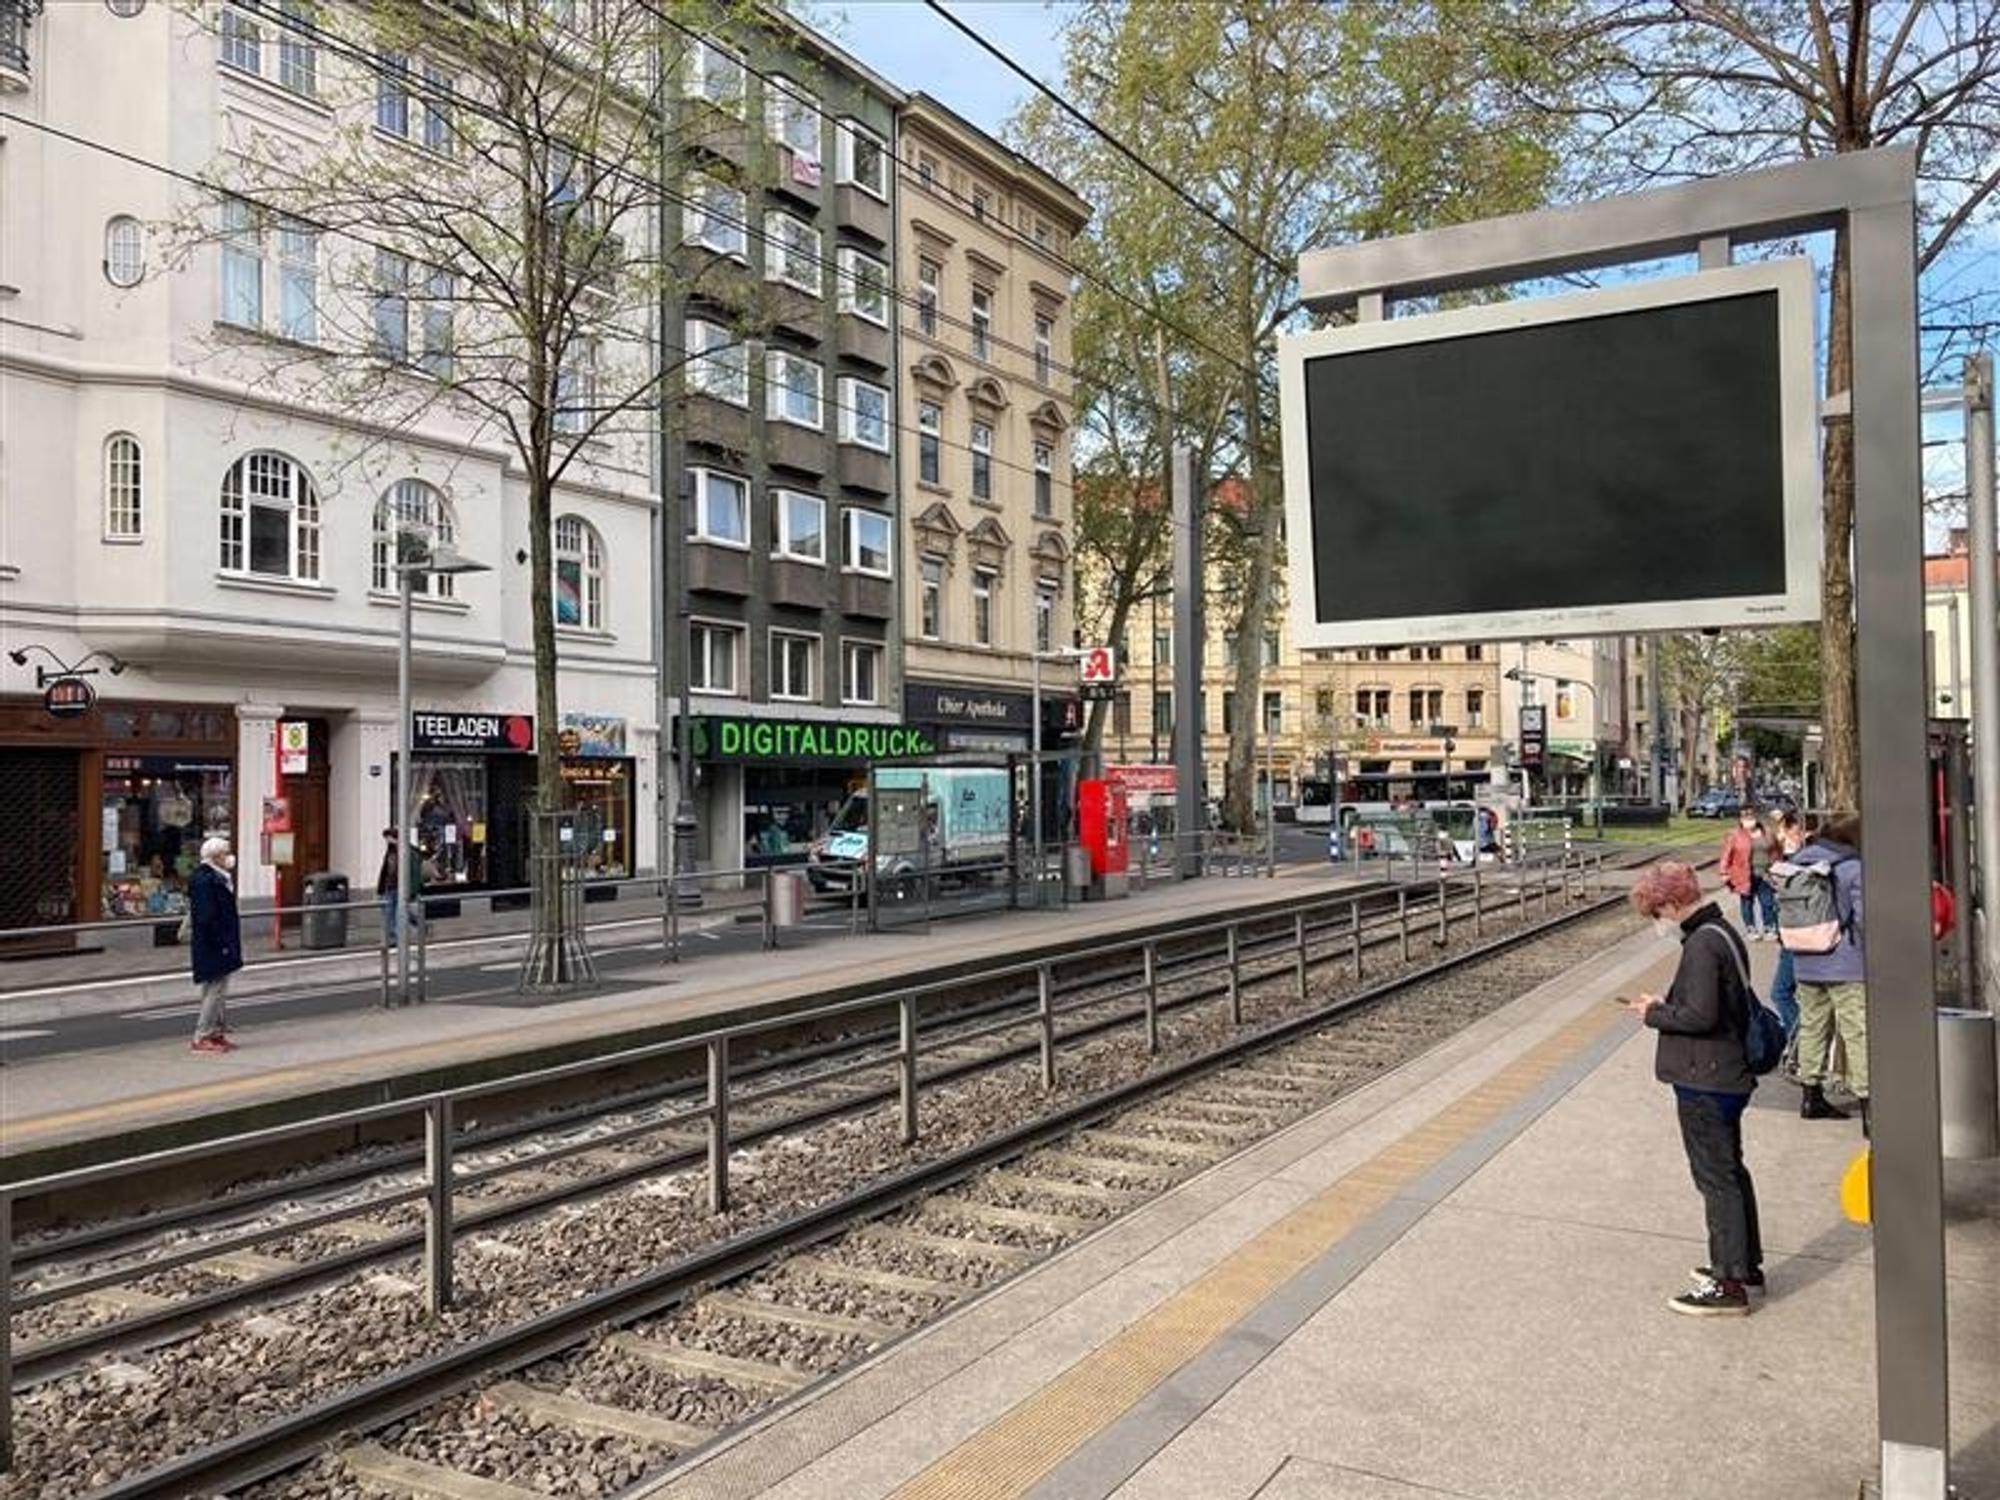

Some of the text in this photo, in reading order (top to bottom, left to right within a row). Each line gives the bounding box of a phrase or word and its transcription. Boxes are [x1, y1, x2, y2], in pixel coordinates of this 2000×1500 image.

[1084, 648, 1111, 679] A
[415, 715, 500, 737] TEELADEN
[721, 721, 921, 757] DIGITALDRUCK
